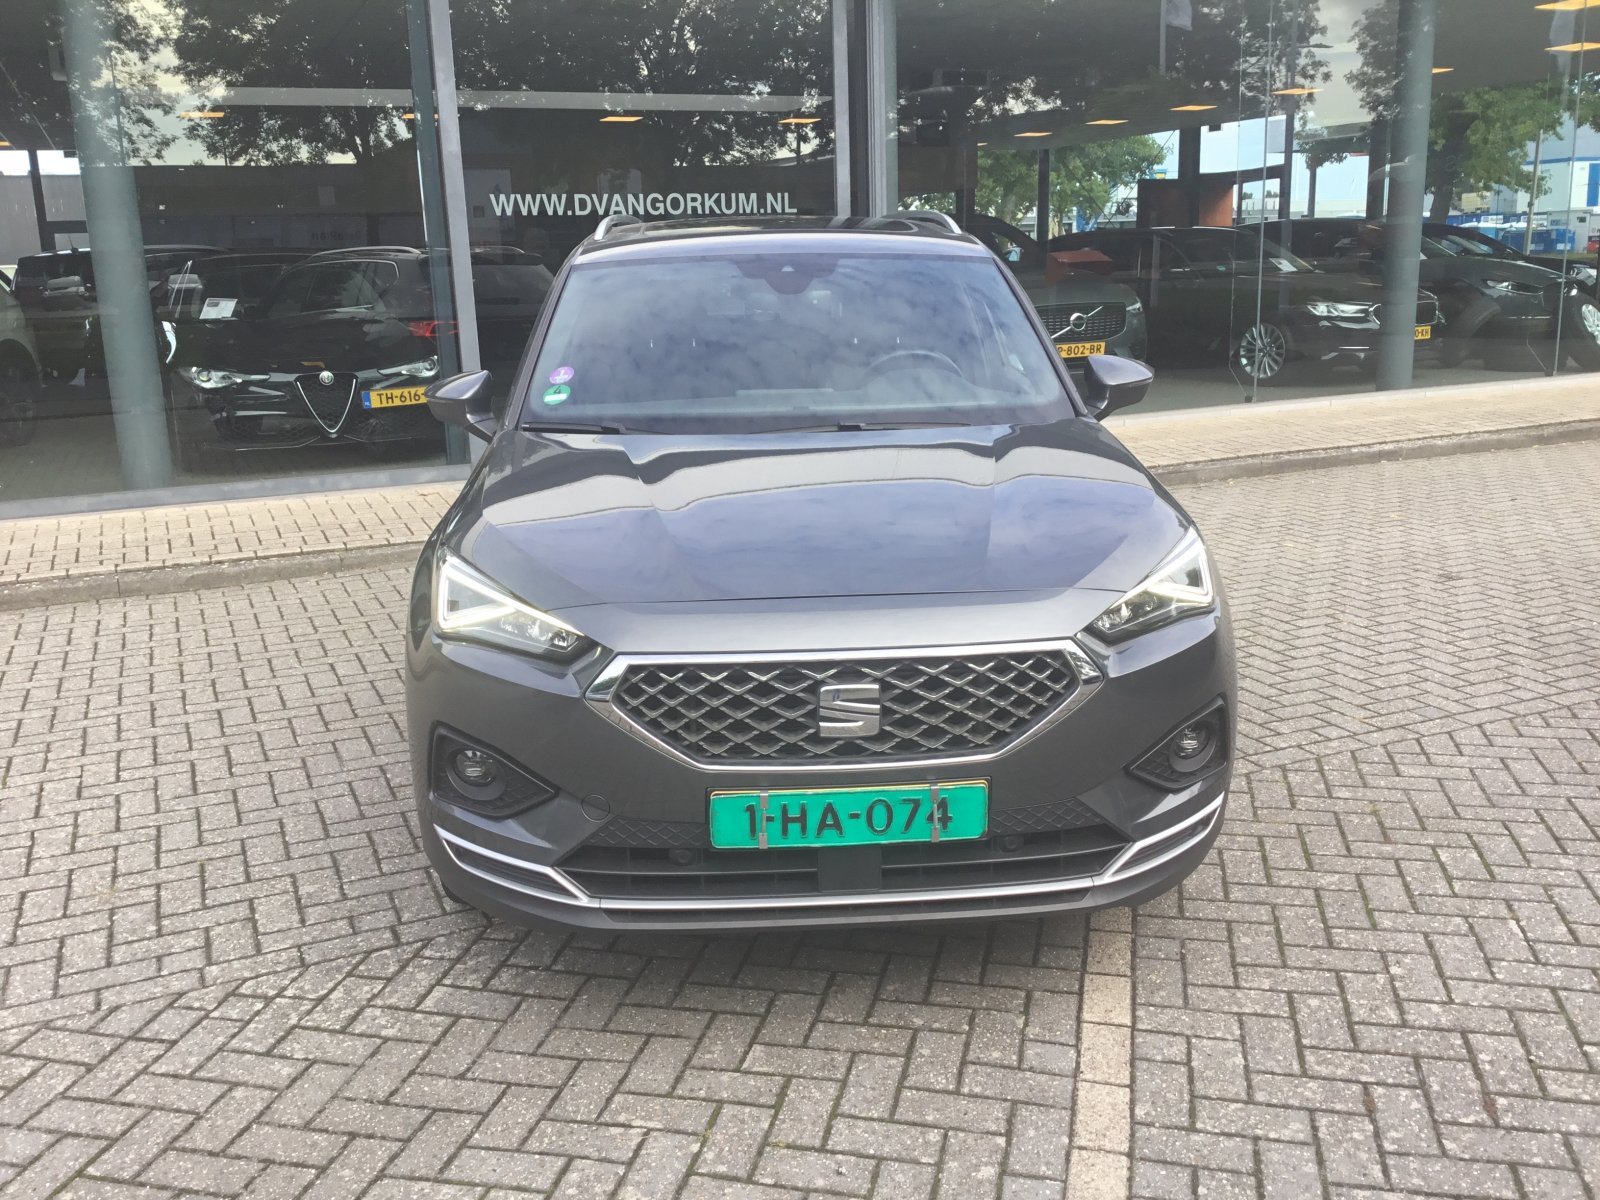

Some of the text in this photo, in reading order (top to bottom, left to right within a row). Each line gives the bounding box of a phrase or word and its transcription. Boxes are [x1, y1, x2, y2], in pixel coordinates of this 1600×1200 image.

[489, 193, 797, 216] WWW.DVANGORKUM.NL
[376, 390, 425, 405] TH-616-
[745, 795, 953, 841] 1-HA-074
